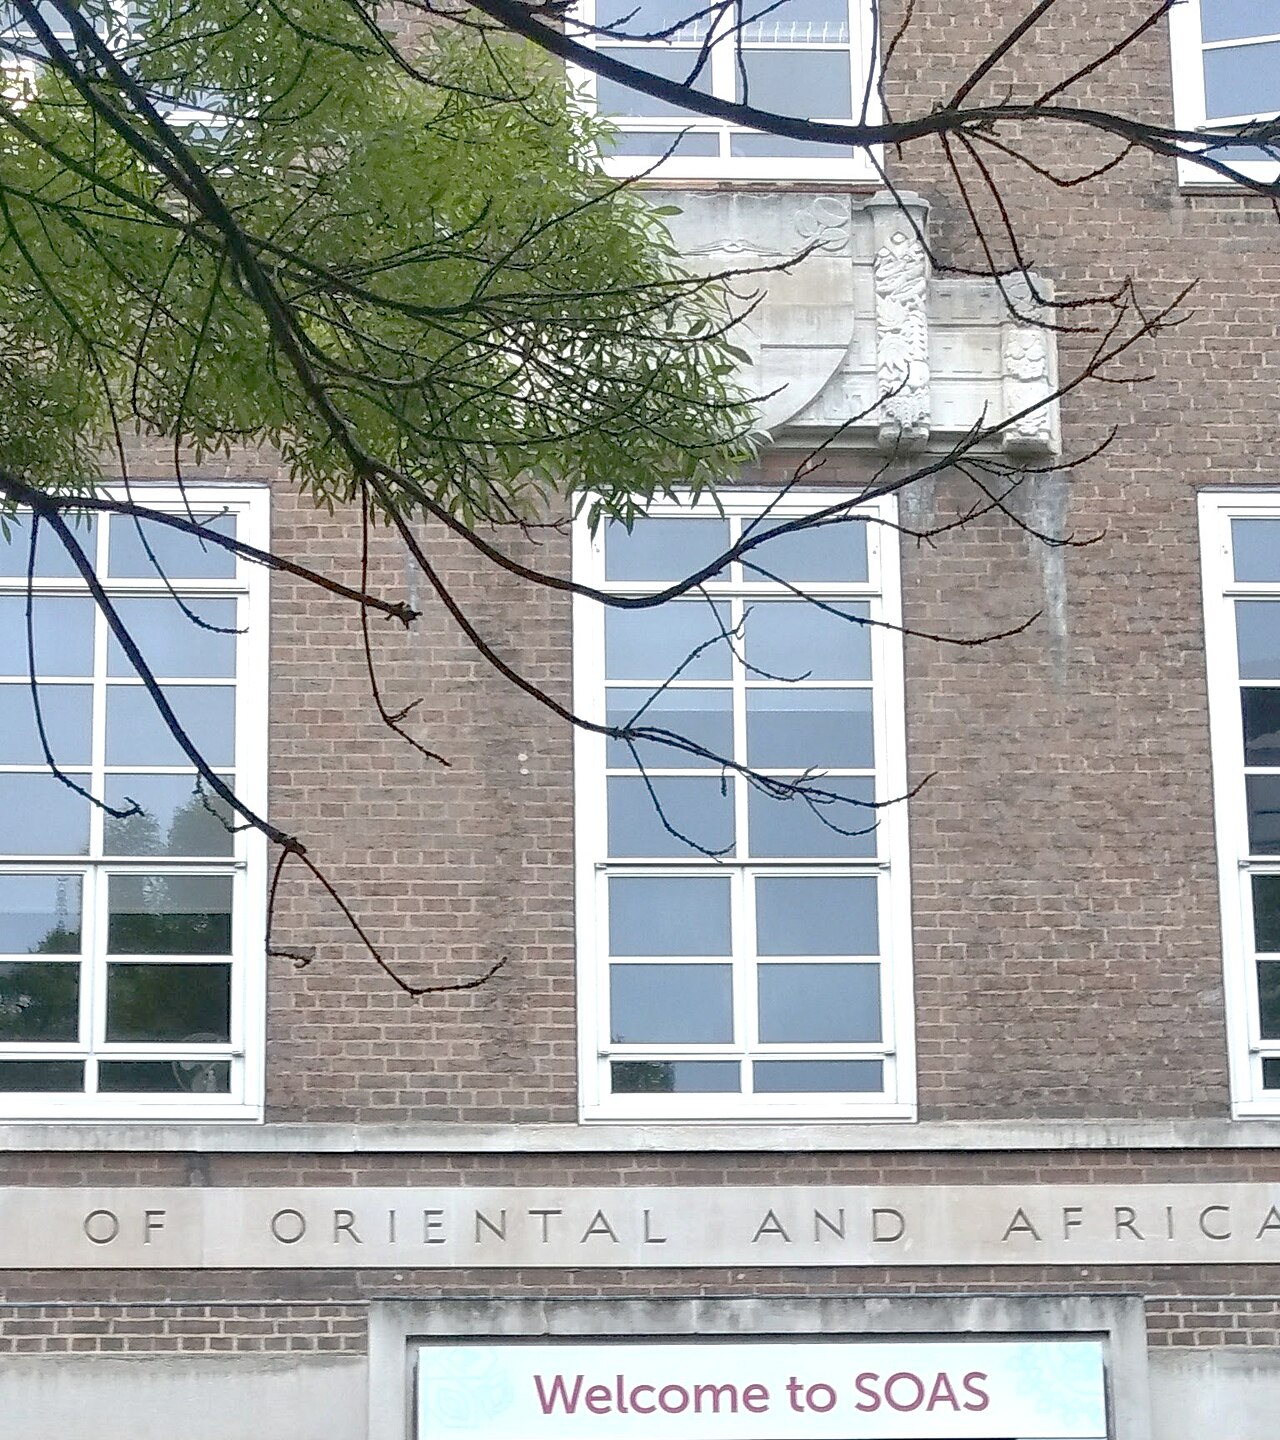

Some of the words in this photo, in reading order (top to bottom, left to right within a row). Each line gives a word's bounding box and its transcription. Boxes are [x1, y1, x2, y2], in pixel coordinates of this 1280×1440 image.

[84, 1208, 167, 1246] OF
[270, 1207, 668, 1245] ORIENTAL
[752, 1207, 908, 1244] AND
[533, 1374, 771, 1415] Welcome
[786, 1376, 838, 1414] to
[854, 1371, 990, 1413] SOAS
